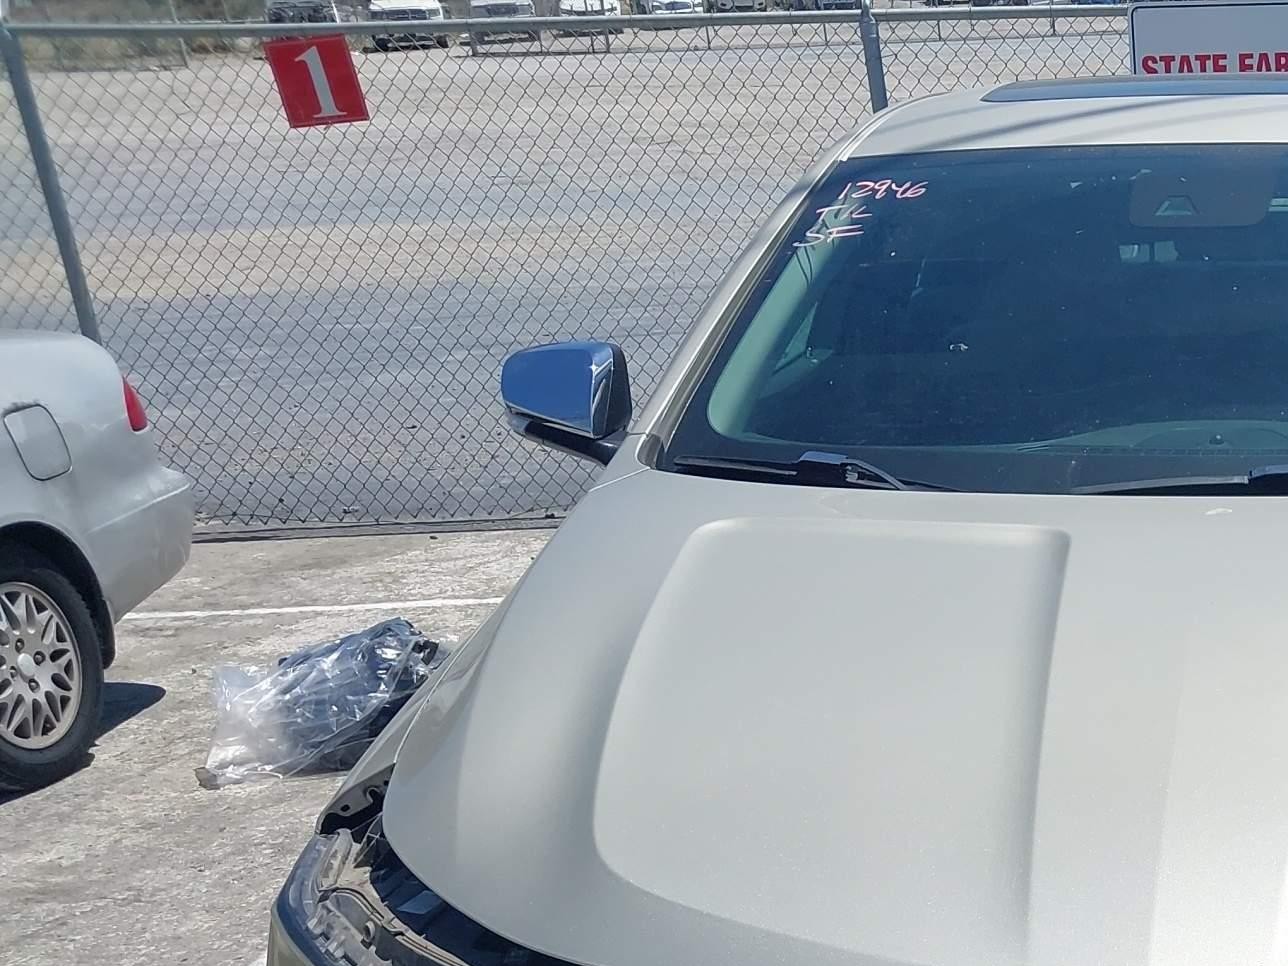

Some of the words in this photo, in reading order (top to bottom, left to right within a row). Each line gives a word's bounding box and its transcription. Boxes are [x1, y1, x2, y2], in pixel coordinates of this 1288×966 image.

[1141, 54, 1228, 74] STATE
[294, 46, 348, 118] 1
[838, 179, 929, 200] 12946
